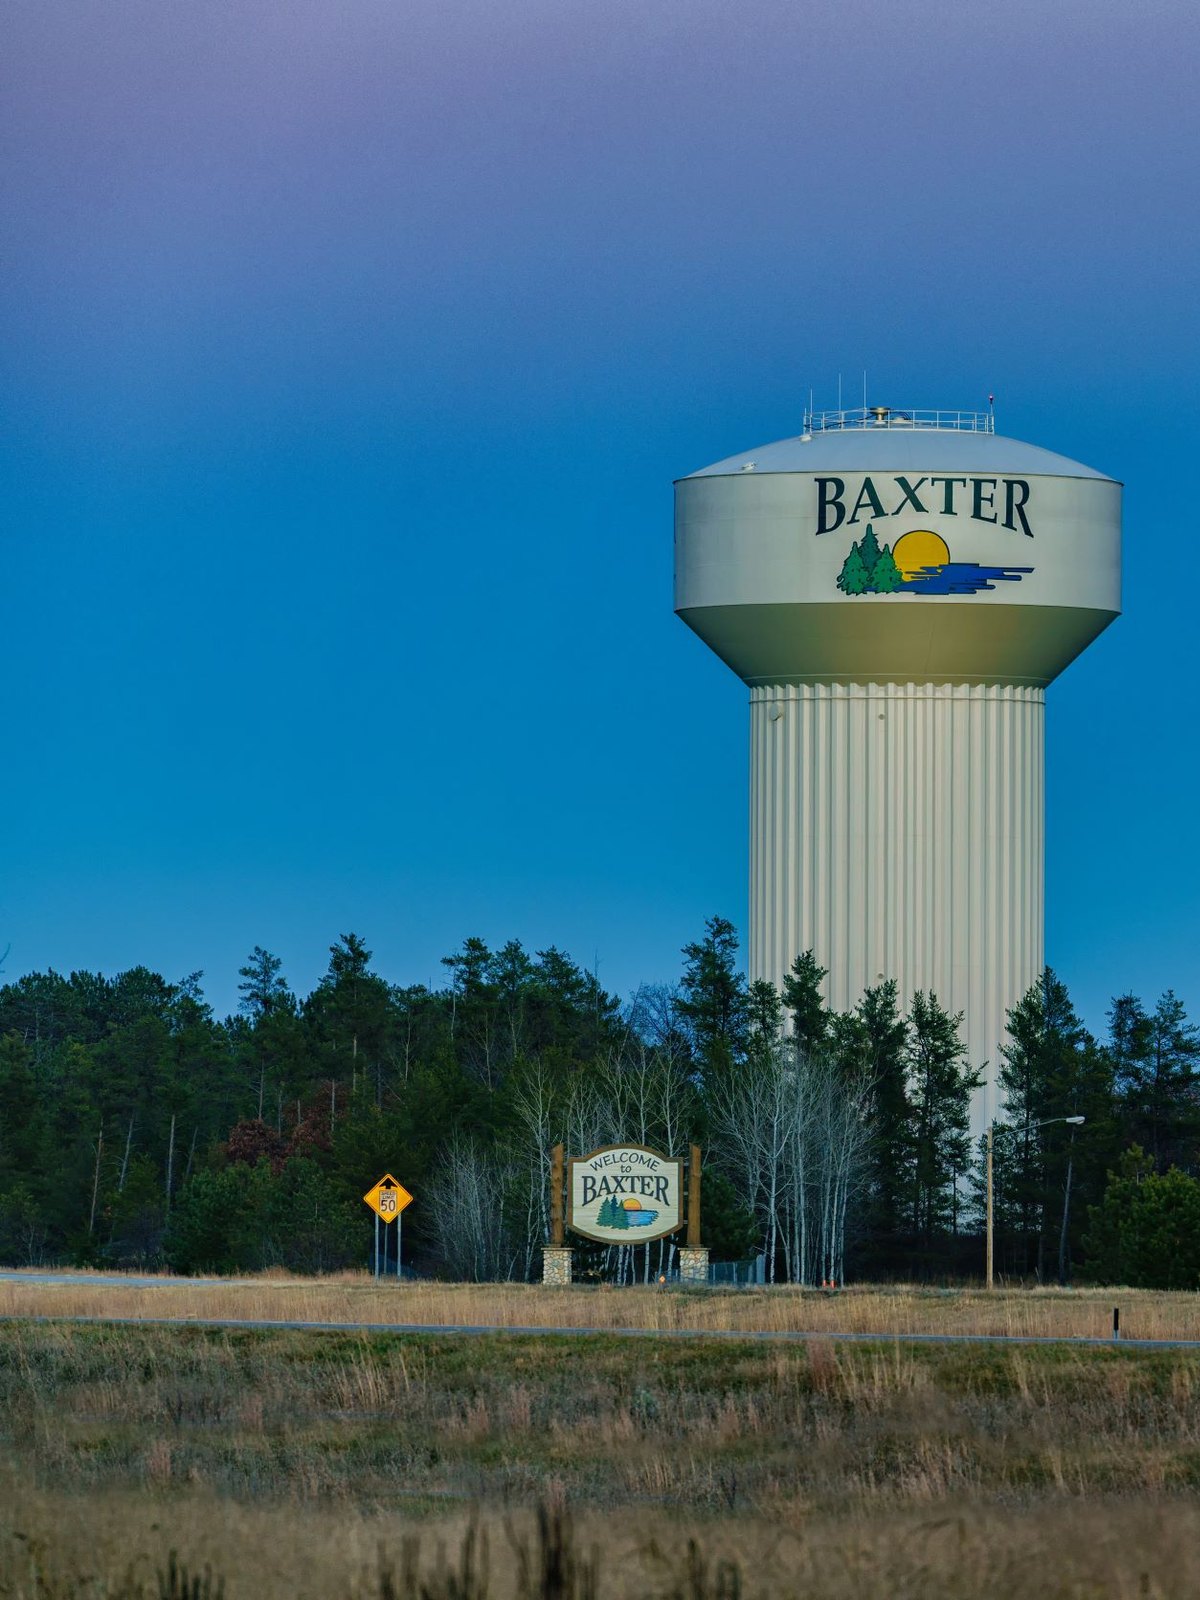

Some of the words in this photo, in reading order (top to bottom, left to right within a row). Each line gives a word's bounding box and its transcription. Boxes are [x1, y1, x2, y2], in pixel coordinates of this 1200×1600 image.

[814, 476, 1034, 538] BAXTER
[590, 1152, 660, 1172] WELCOME
[620, 1164, 632, 1173] to
[581, 1175, 670, 1207] BAXTER
[381, 1200, 396, 1211] 50
